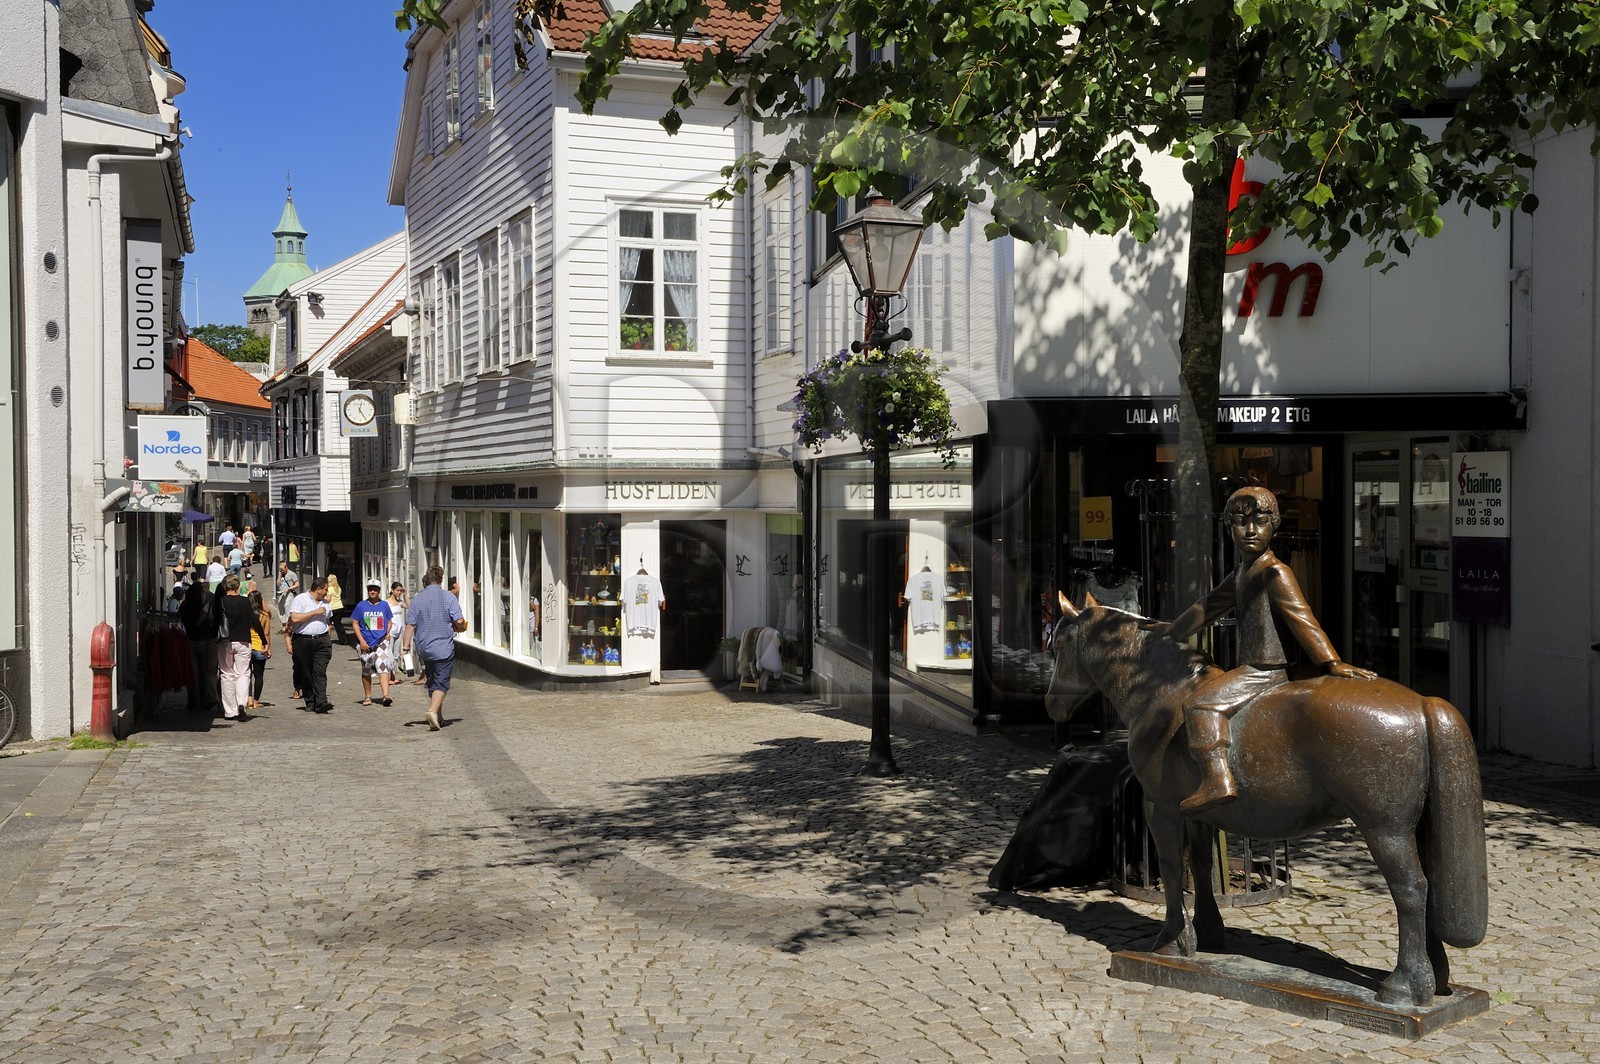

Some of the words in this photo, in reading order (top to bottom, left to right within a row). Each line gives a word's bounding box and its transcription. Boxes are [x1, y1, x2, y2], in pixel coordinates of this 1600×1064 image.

[1126, 408, 1158, 424] LAILA
[1217, 407, 1267, 423] MAKEUP
[1271, 407, 1280, 423] 2
[1286, 407, 1310, 423] ETG
[143, 443, 202, 455] Nordea
[1466, 472, 1502, 494] bailine
[604, 481, 717, 500] HUSFLIDEN
[1457, 498, 1475, 507] MAN
[1485, 498, 1502, 507] TOR
[1467, 508, 1476, 517] 10
[1455, 517, 1464, 526] 51
[1466, 517, 1477, 526] 89
[1480, 517, 1491, 526] 56
[1493, 517, 1505, 526] 90
[1459, 568, 1500, 580] LAILA
